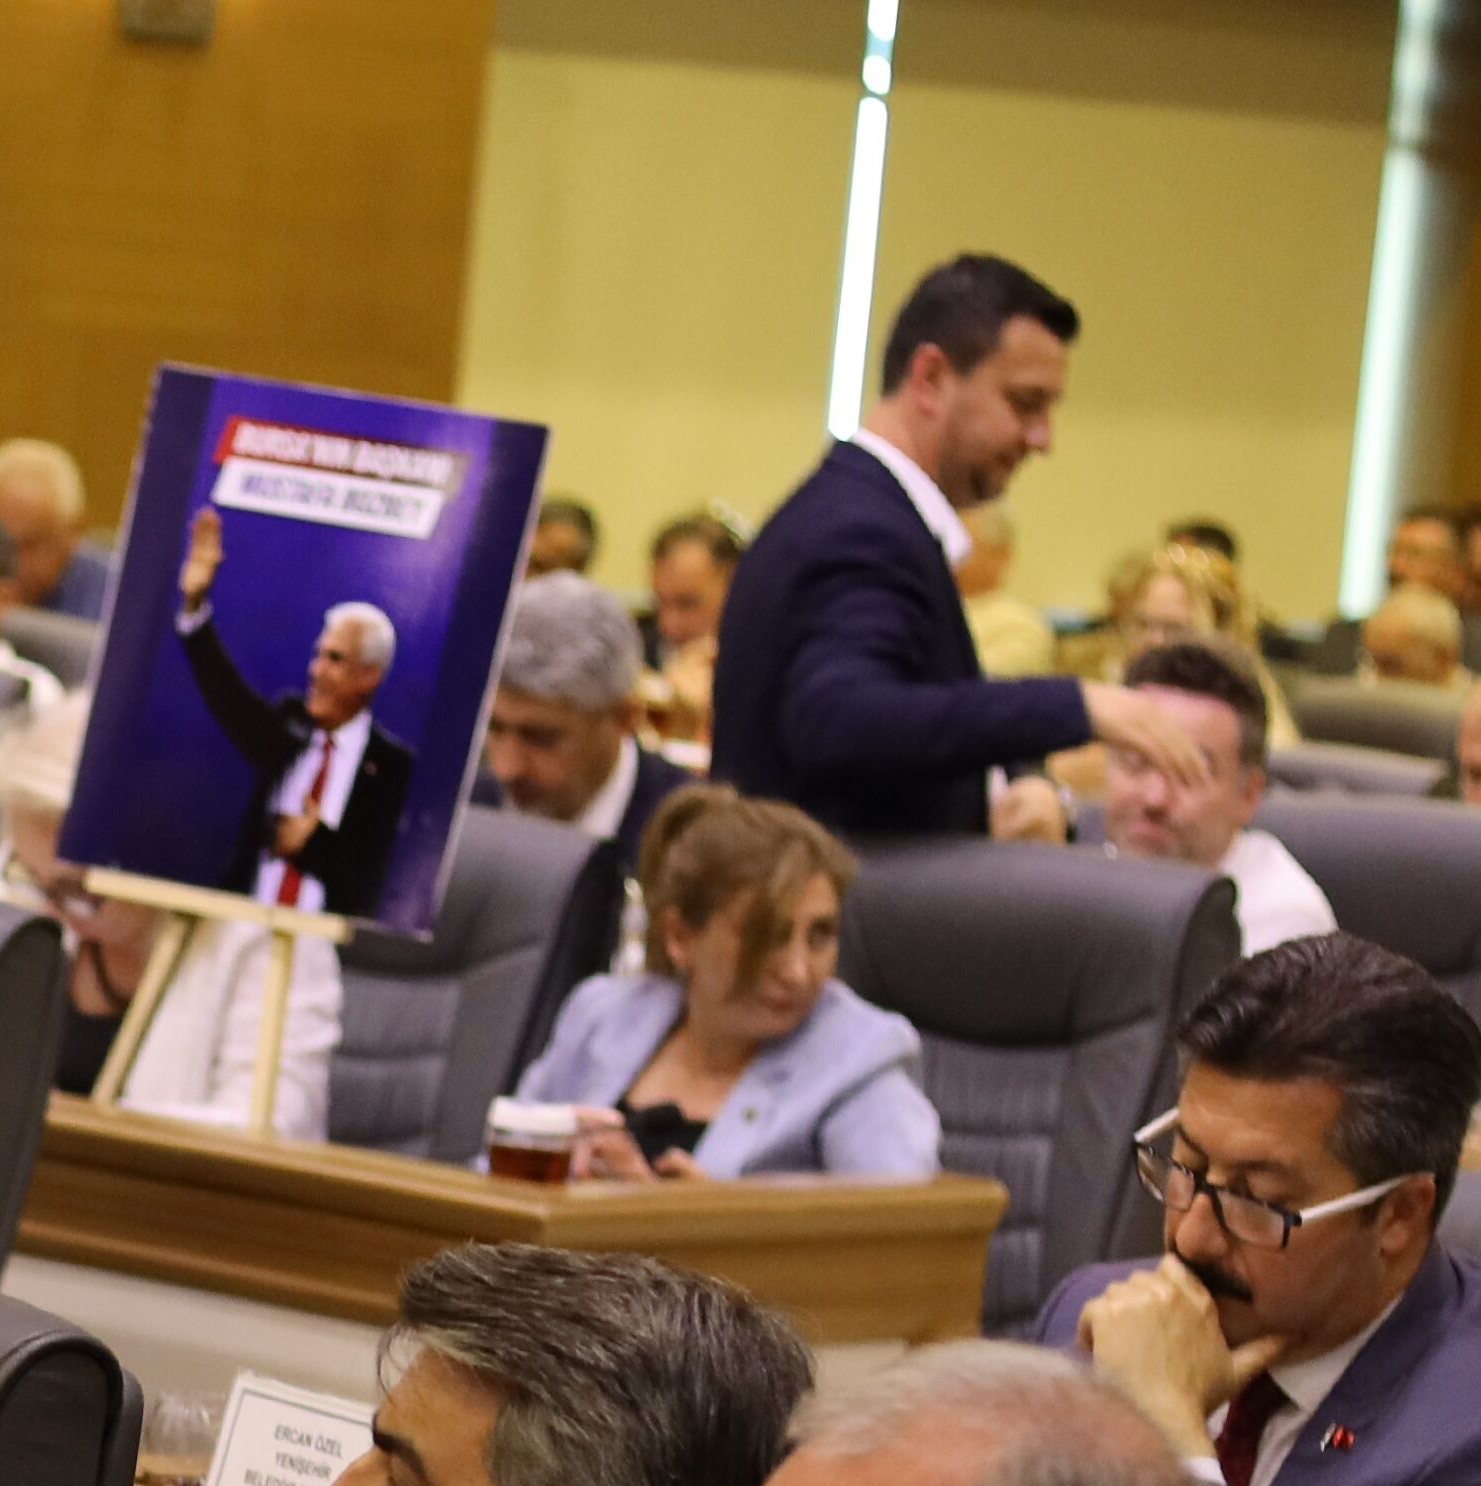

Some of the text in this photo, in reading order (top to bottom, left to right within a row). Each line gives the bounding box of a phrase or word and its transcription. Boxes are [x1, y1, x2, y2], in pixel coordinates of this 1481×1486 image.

[275, 1424, 343, 1459] ERCAN ÖZEL
[275, 1451, 333, 1481] YENİŞEHİR
